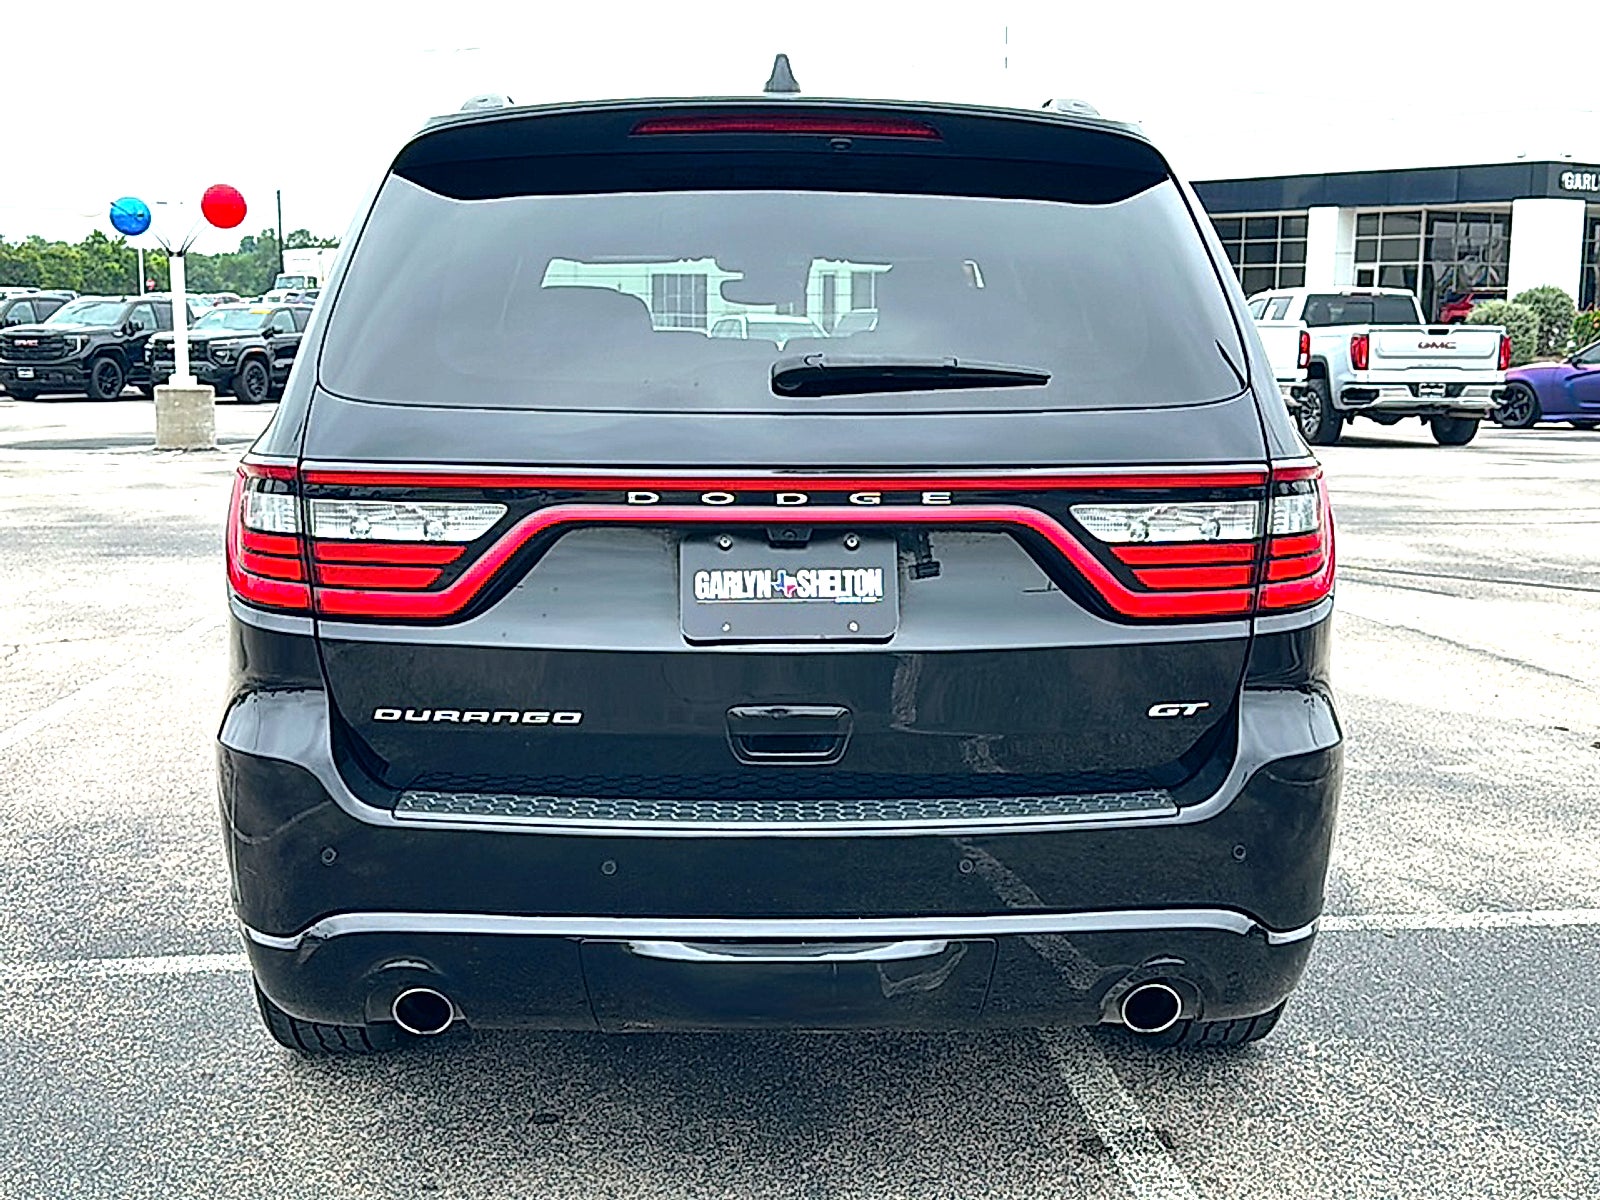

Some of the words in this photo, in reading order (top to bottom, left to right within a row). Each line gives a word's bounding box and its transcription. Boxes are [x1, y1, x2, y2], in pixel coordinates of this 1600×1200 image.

[1561, 171, 1600, 191] GARL
[1418, 341, 1457, 350] GMC
[627, 491, 952, 505] DODGE
[694, 569, 772, 600] GARLYN
[796, 568, 883, 598] SHELTON
[374, 708, 583, 724] DURANGO
[1148, 702, 1210, 717] GT
